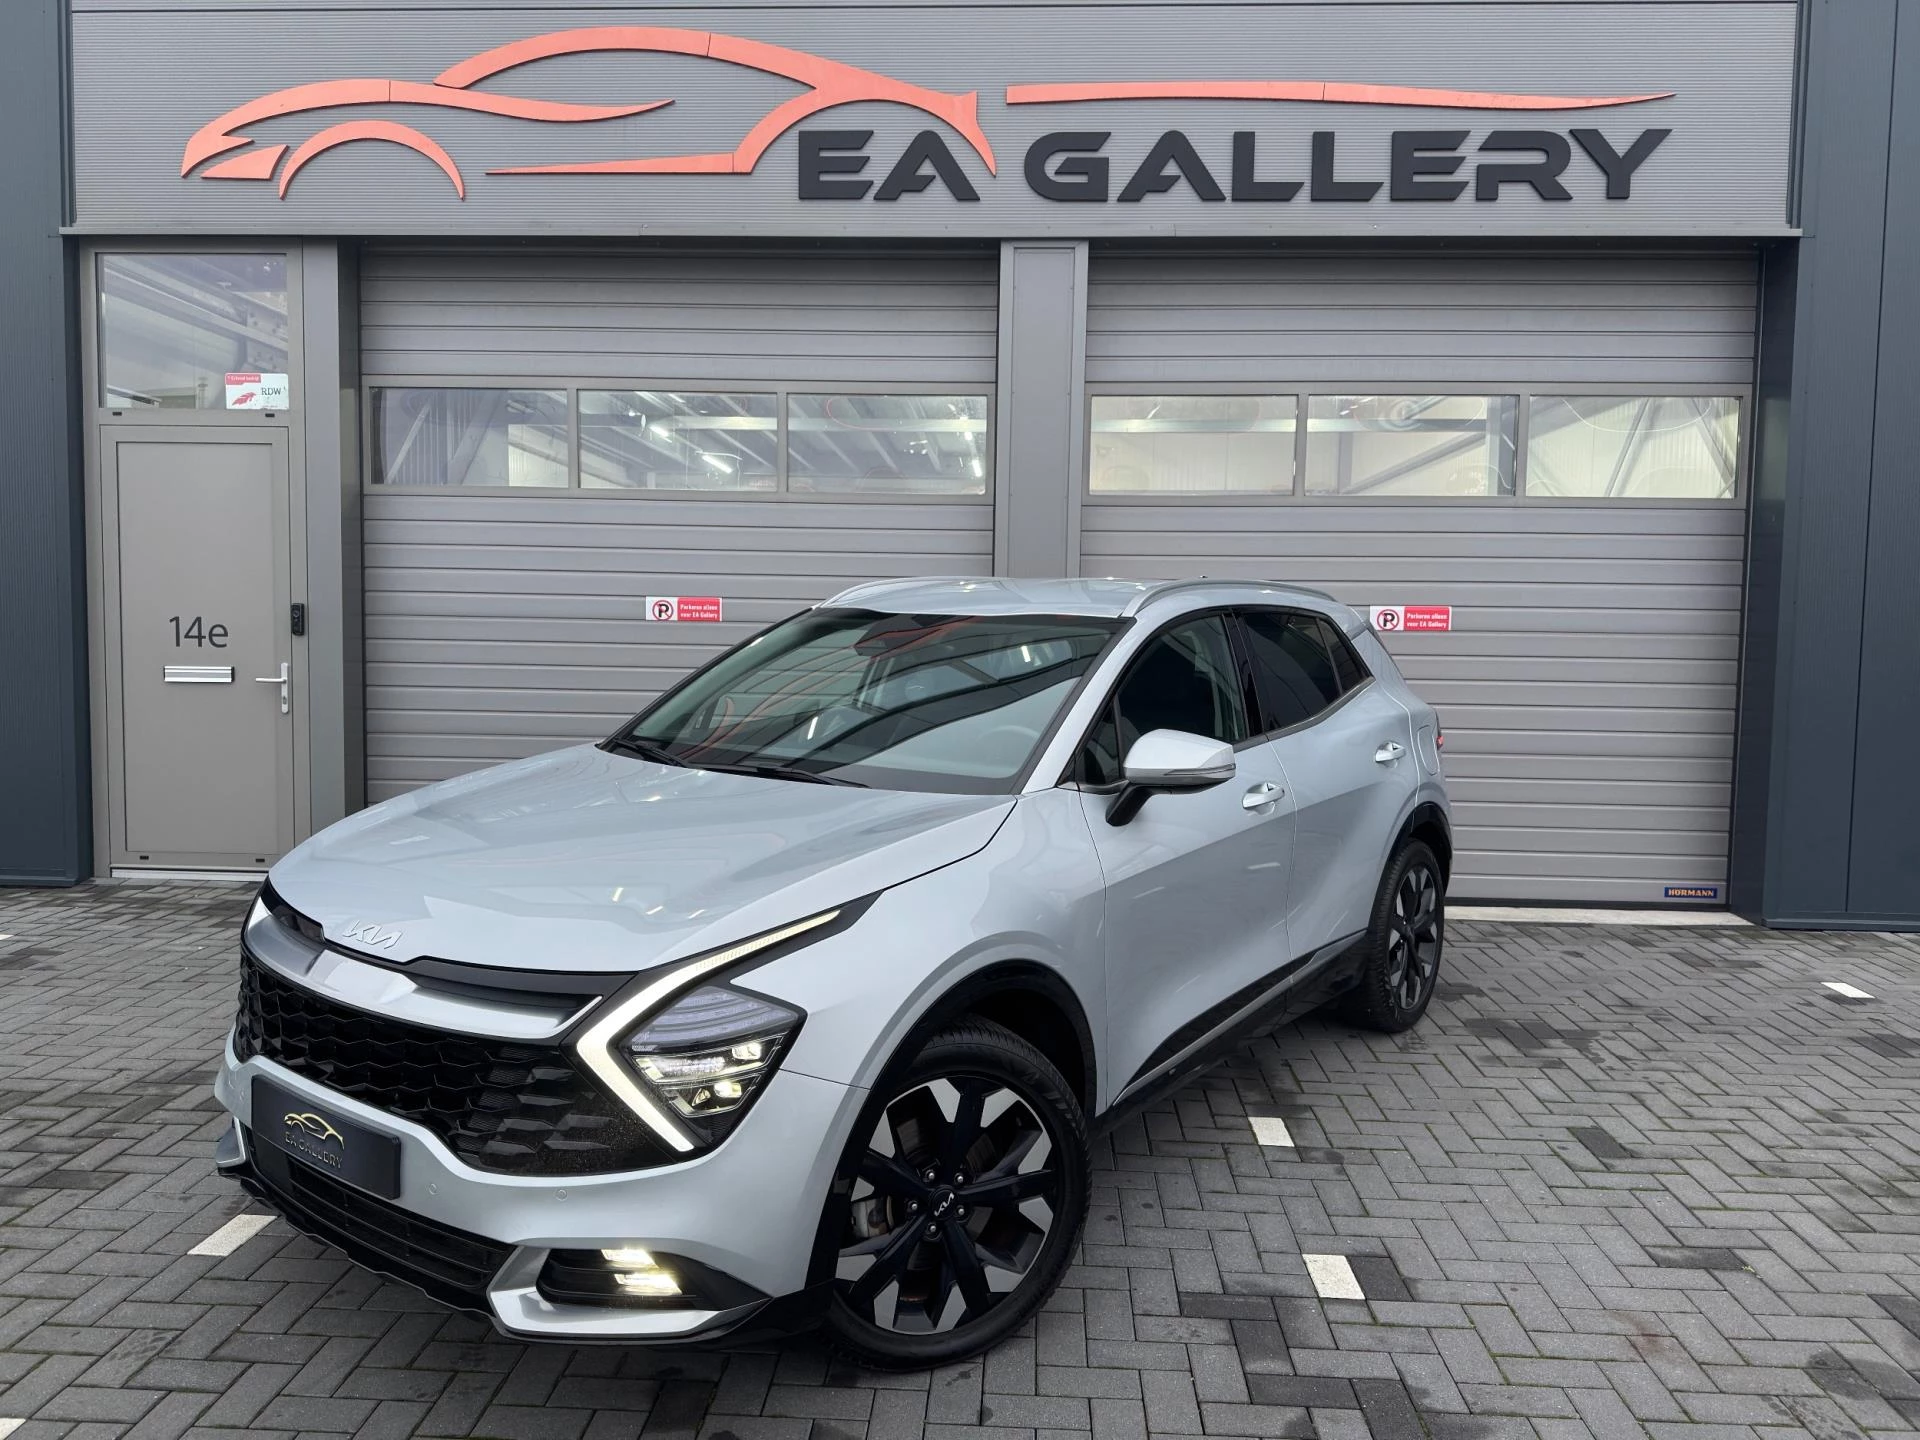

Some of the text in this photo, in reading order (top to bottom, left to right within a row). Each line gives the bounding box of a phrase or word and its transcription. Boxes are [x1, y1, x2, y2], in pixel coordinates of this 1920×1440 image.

[799, 128, 1671, 202] EA GALLERY
[261, 387, 281, 396] RDW
[700, 611, 718, 620] Gallery
[1428, 621, 1447, 629] Gallery
[169, 615, 229, 648] 14e
[285, 1131, 343, 1169] EA GALLERY
